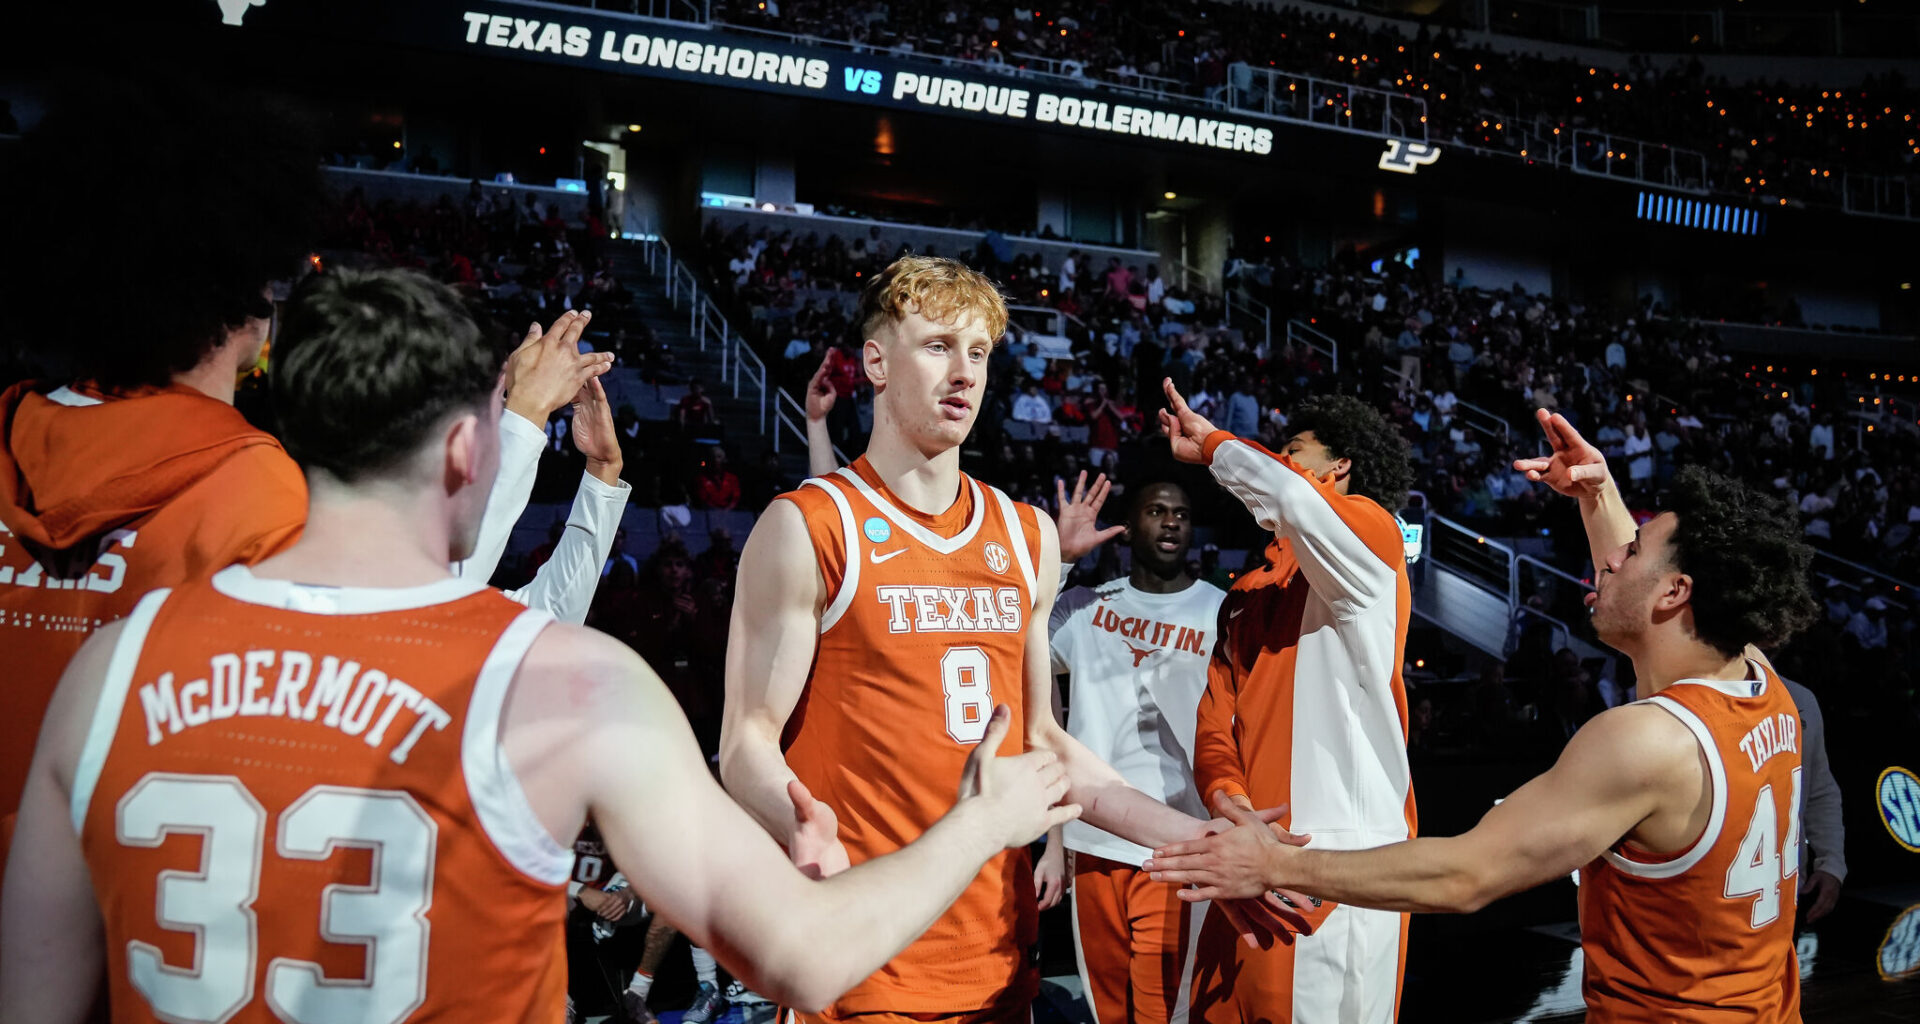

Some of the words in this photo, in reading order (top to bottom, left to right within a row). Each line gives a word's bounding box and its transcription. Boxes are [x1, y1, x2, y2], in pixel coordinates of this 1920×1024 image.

[463, 11, 592, 57] TEXAS
[599, 30, 830, 89] LONGHORNS
[843, 66, 883, 95] VS
[892, 71, 1030, 118] PURDUE
[1035, 93, 1274, 155] BOILERMAKERS
[1378, 139, 1442, 174] P
[867, 528, 890, 538] NCAA
[985, 542, 1008, 572] SEC
[876, 585, 1022, 633] TEXAS
[1092, 605, 1150, 641] LOCK
[1151, 622, 1176, 647] IT
[1175, 626, 1206, 656] IN.
[140, 650, 451, 764] McDERMOTT
[940, 646, 994, 744] 8
[1739, 713, 1798, 773] TAYLOR
[116, 772, 438, 1024] 33
